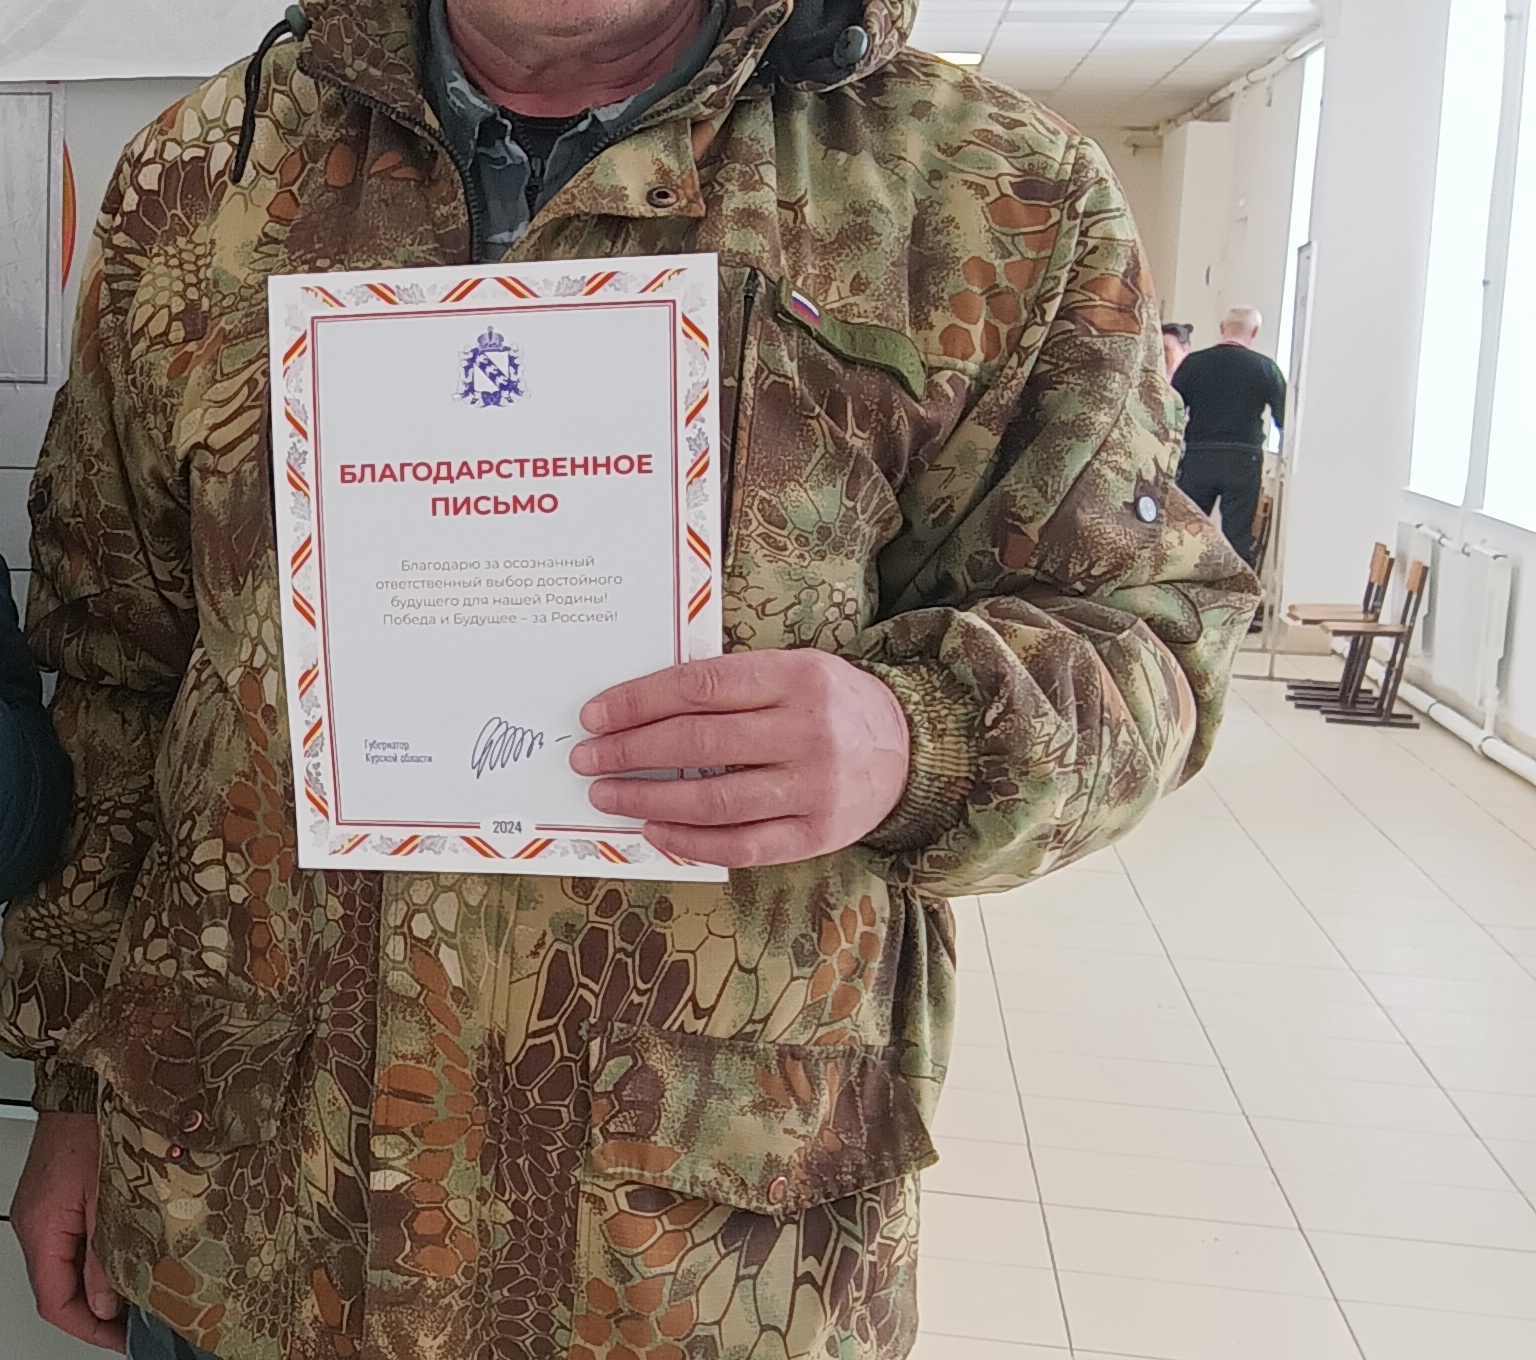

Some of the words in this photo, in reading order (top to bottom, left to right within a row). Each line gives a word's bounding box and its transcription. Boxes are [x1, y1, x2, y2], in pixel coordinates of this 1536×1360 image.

[339, 454, 654, 484] БЛАГОДАРСТВЕННОЕ
[431, 493, 559, 517] ПИСЬМО
[401, 559, 480, 573] Благодарю
[484, 561, 500, 570] за
[503, 556, 595, 570] осознанный
[375, 577, 482, 590] ответственный
[486, 574, 533, 589] выбор
[536, 574, 623, 588] достойного
[390, 595, 459, 610] будущего
[462, 598, 489, 608] для
[493, 594, 542, 606] нашей
[545, 592, 608, 606] Родины!
[383, 613, 436, 627] Победа
[441, 615, 449, 624] и
[453, 613, 517, 628] Будущее
[532, 614, 547, 624] за
[551, 611, 618, 624] Россией!
[364, 739, 409, 752] Губернатор
[365, 753, 397, 764] Курской
[400, 753, 433, 763] области
[492, 820, 523, 834] 2024
